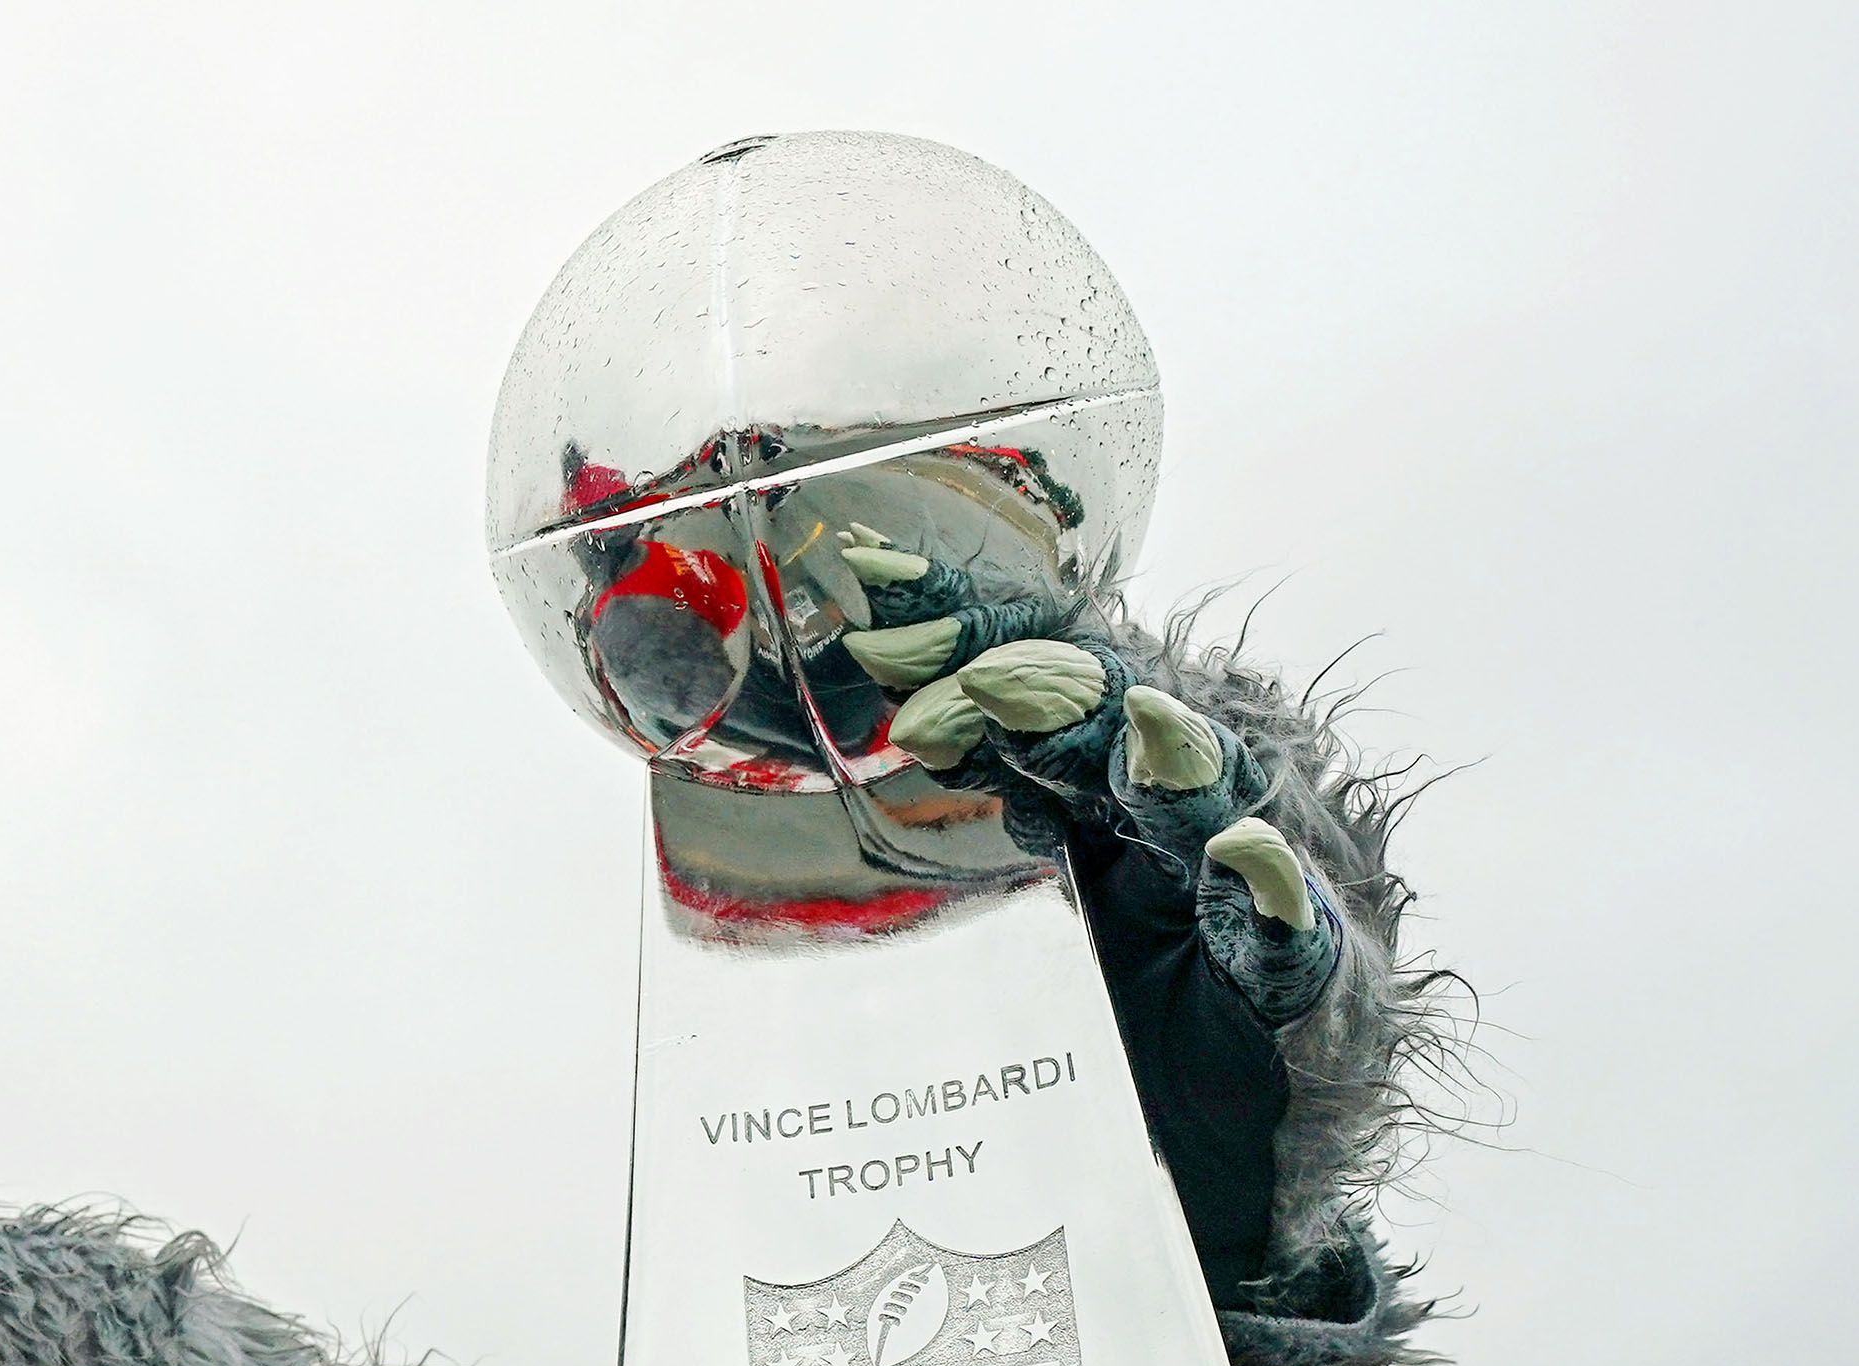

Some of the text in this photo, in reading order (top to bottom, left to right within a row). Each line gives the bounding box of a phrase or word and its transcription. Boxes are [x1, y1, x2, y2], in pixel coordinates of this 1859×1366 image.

[699, 1051, 1077, 1145] VINCE LOMBARDI
[797, 1140, 984, 1200] TROPHY
